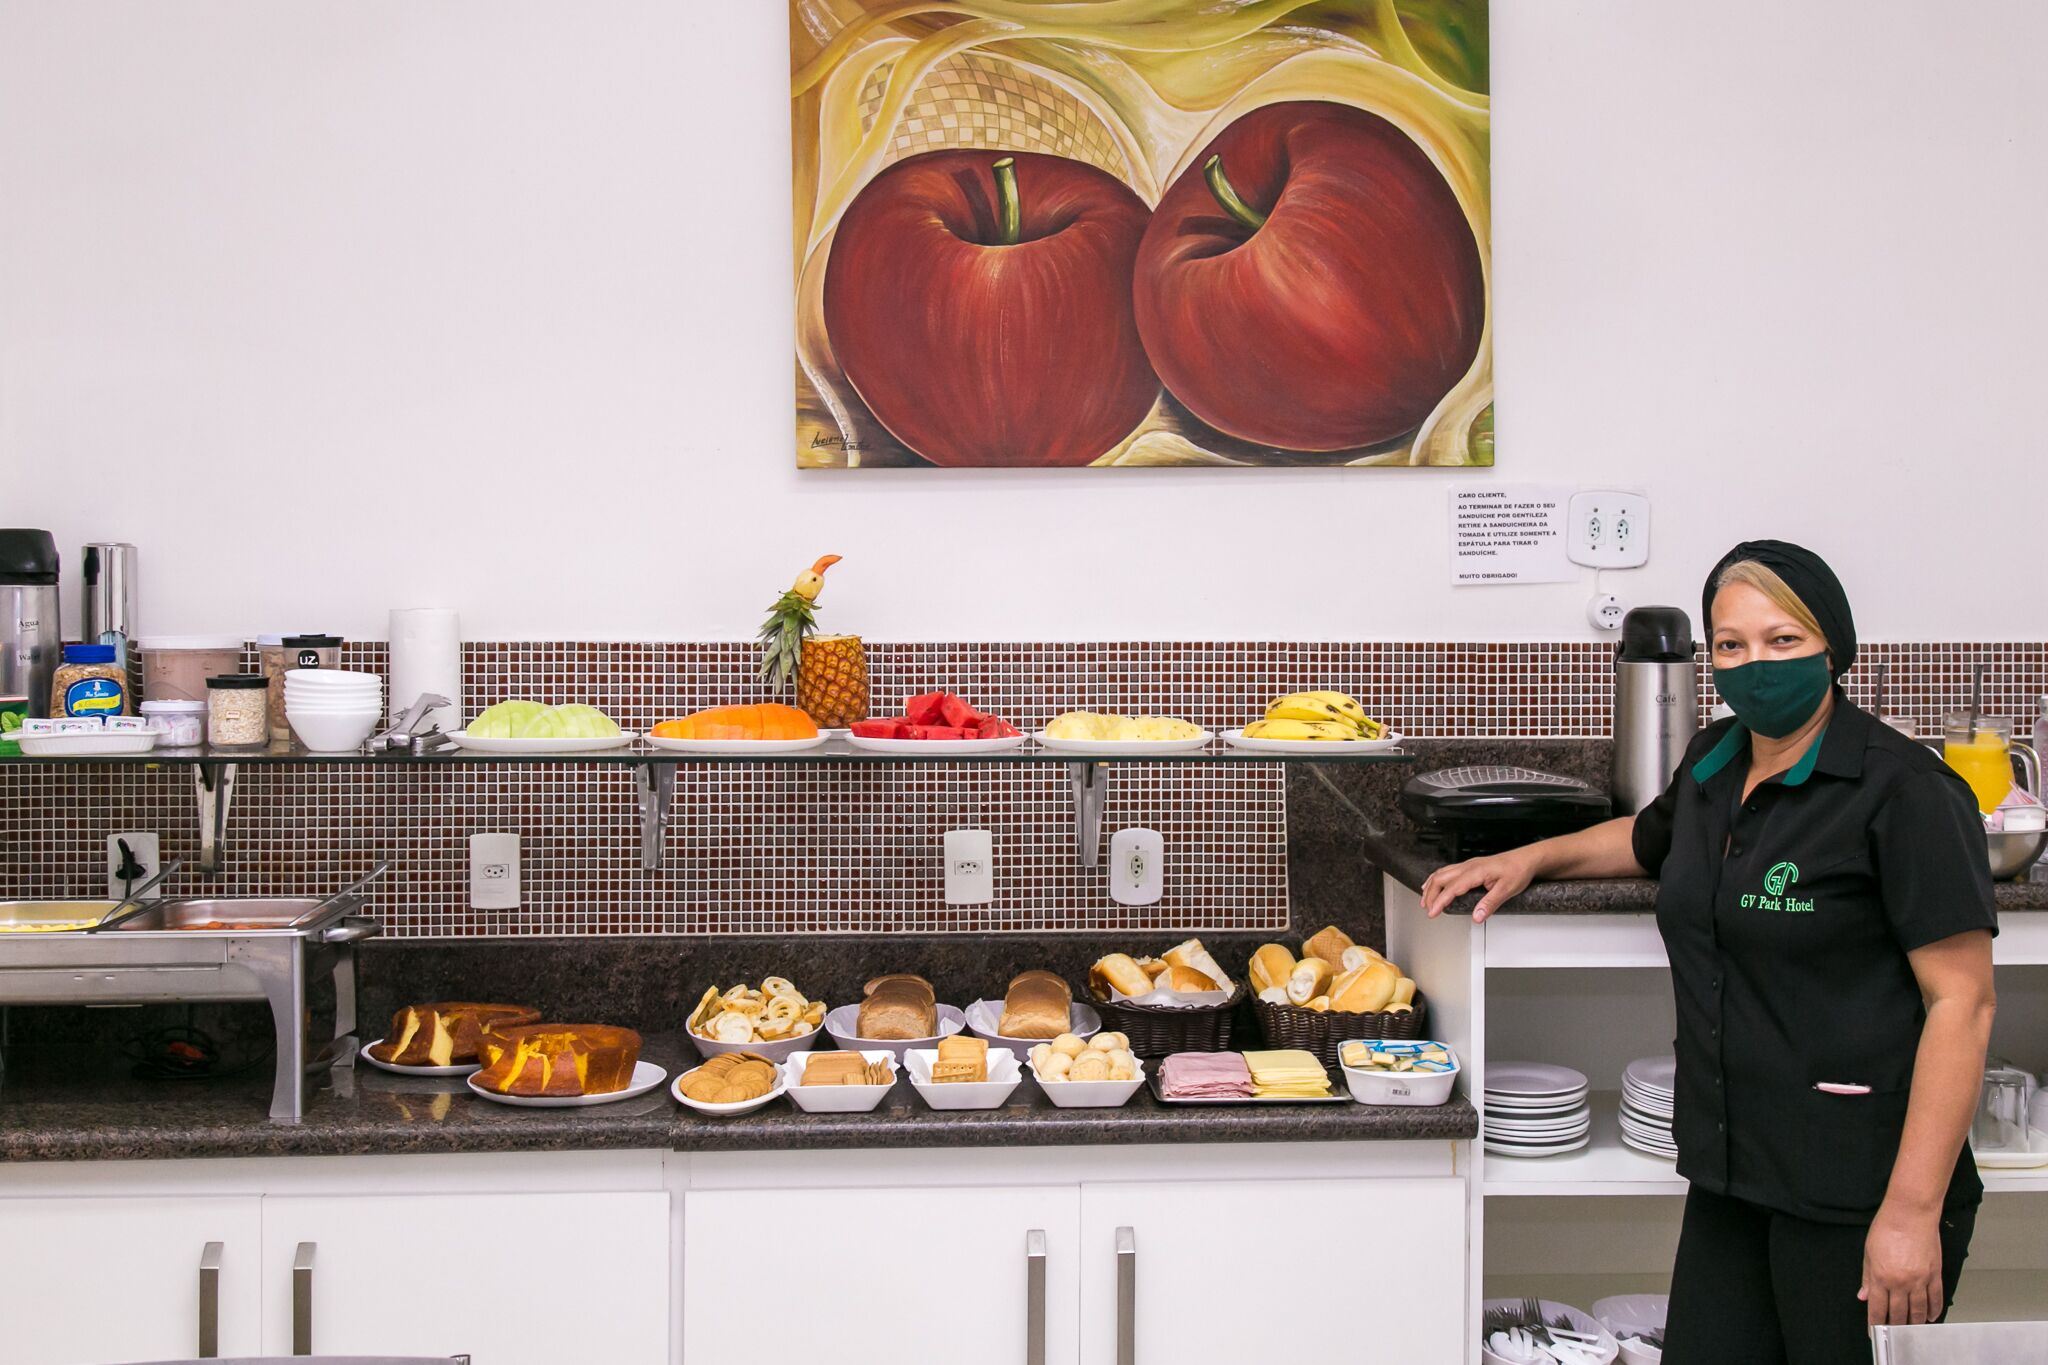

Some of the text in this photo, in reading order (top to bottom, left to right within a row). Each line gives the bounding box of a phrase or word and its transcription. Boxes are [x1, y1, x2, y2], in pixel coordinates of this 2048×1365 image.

[1656, 694, 1676, 703] Café
[1740, 894, 1814, 912] GV Park Hotel
